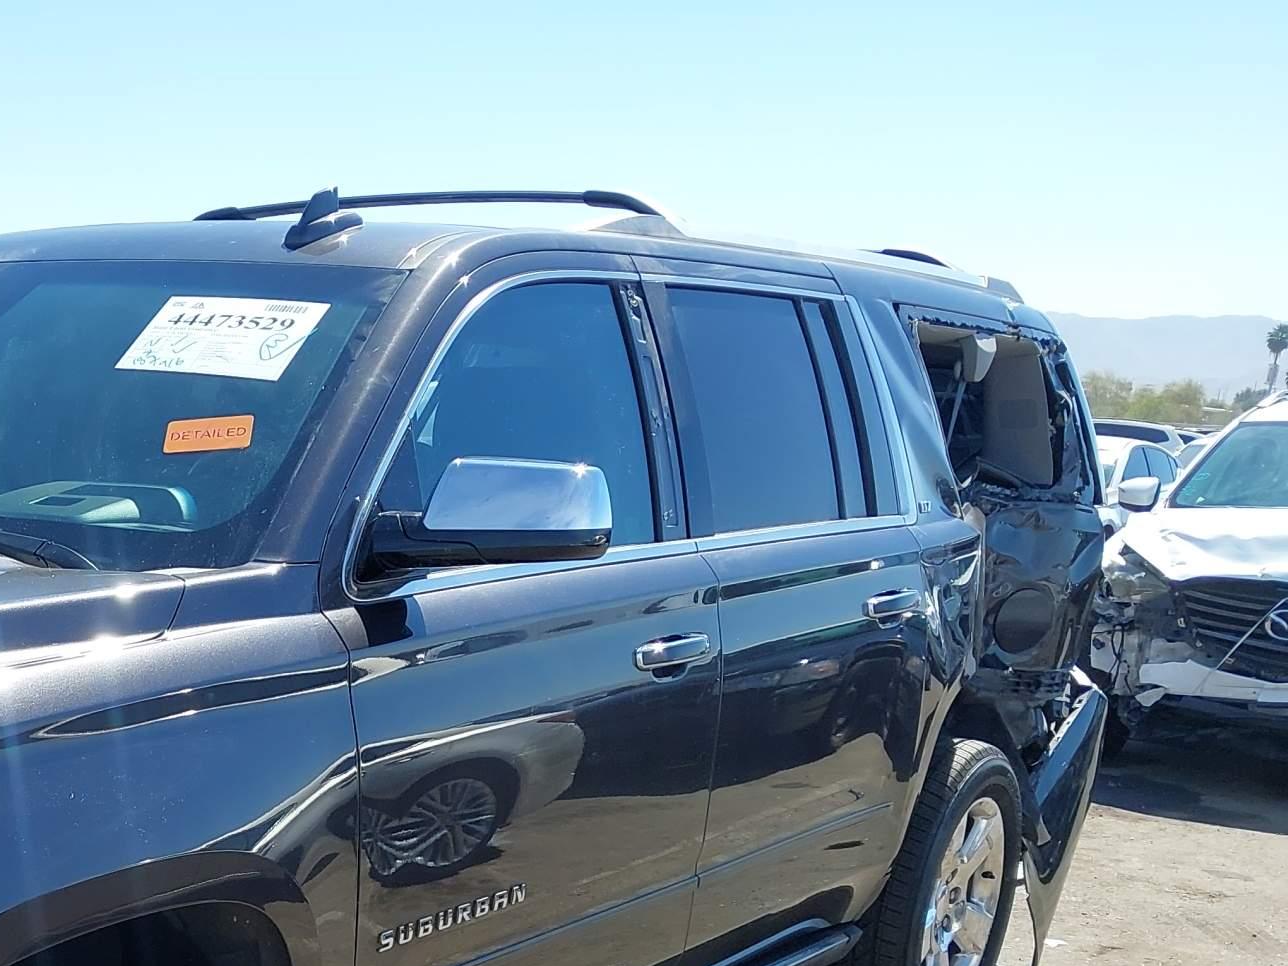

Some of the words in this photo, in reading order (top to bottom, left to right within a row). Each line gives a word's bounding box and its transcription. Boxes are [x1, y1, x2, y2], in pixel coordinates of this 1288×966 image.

[167, 312, 296, 332] 44473529
[170, 426, 248, 441] DETAILED
[378, 883, 528, 953] SUBURBAN
